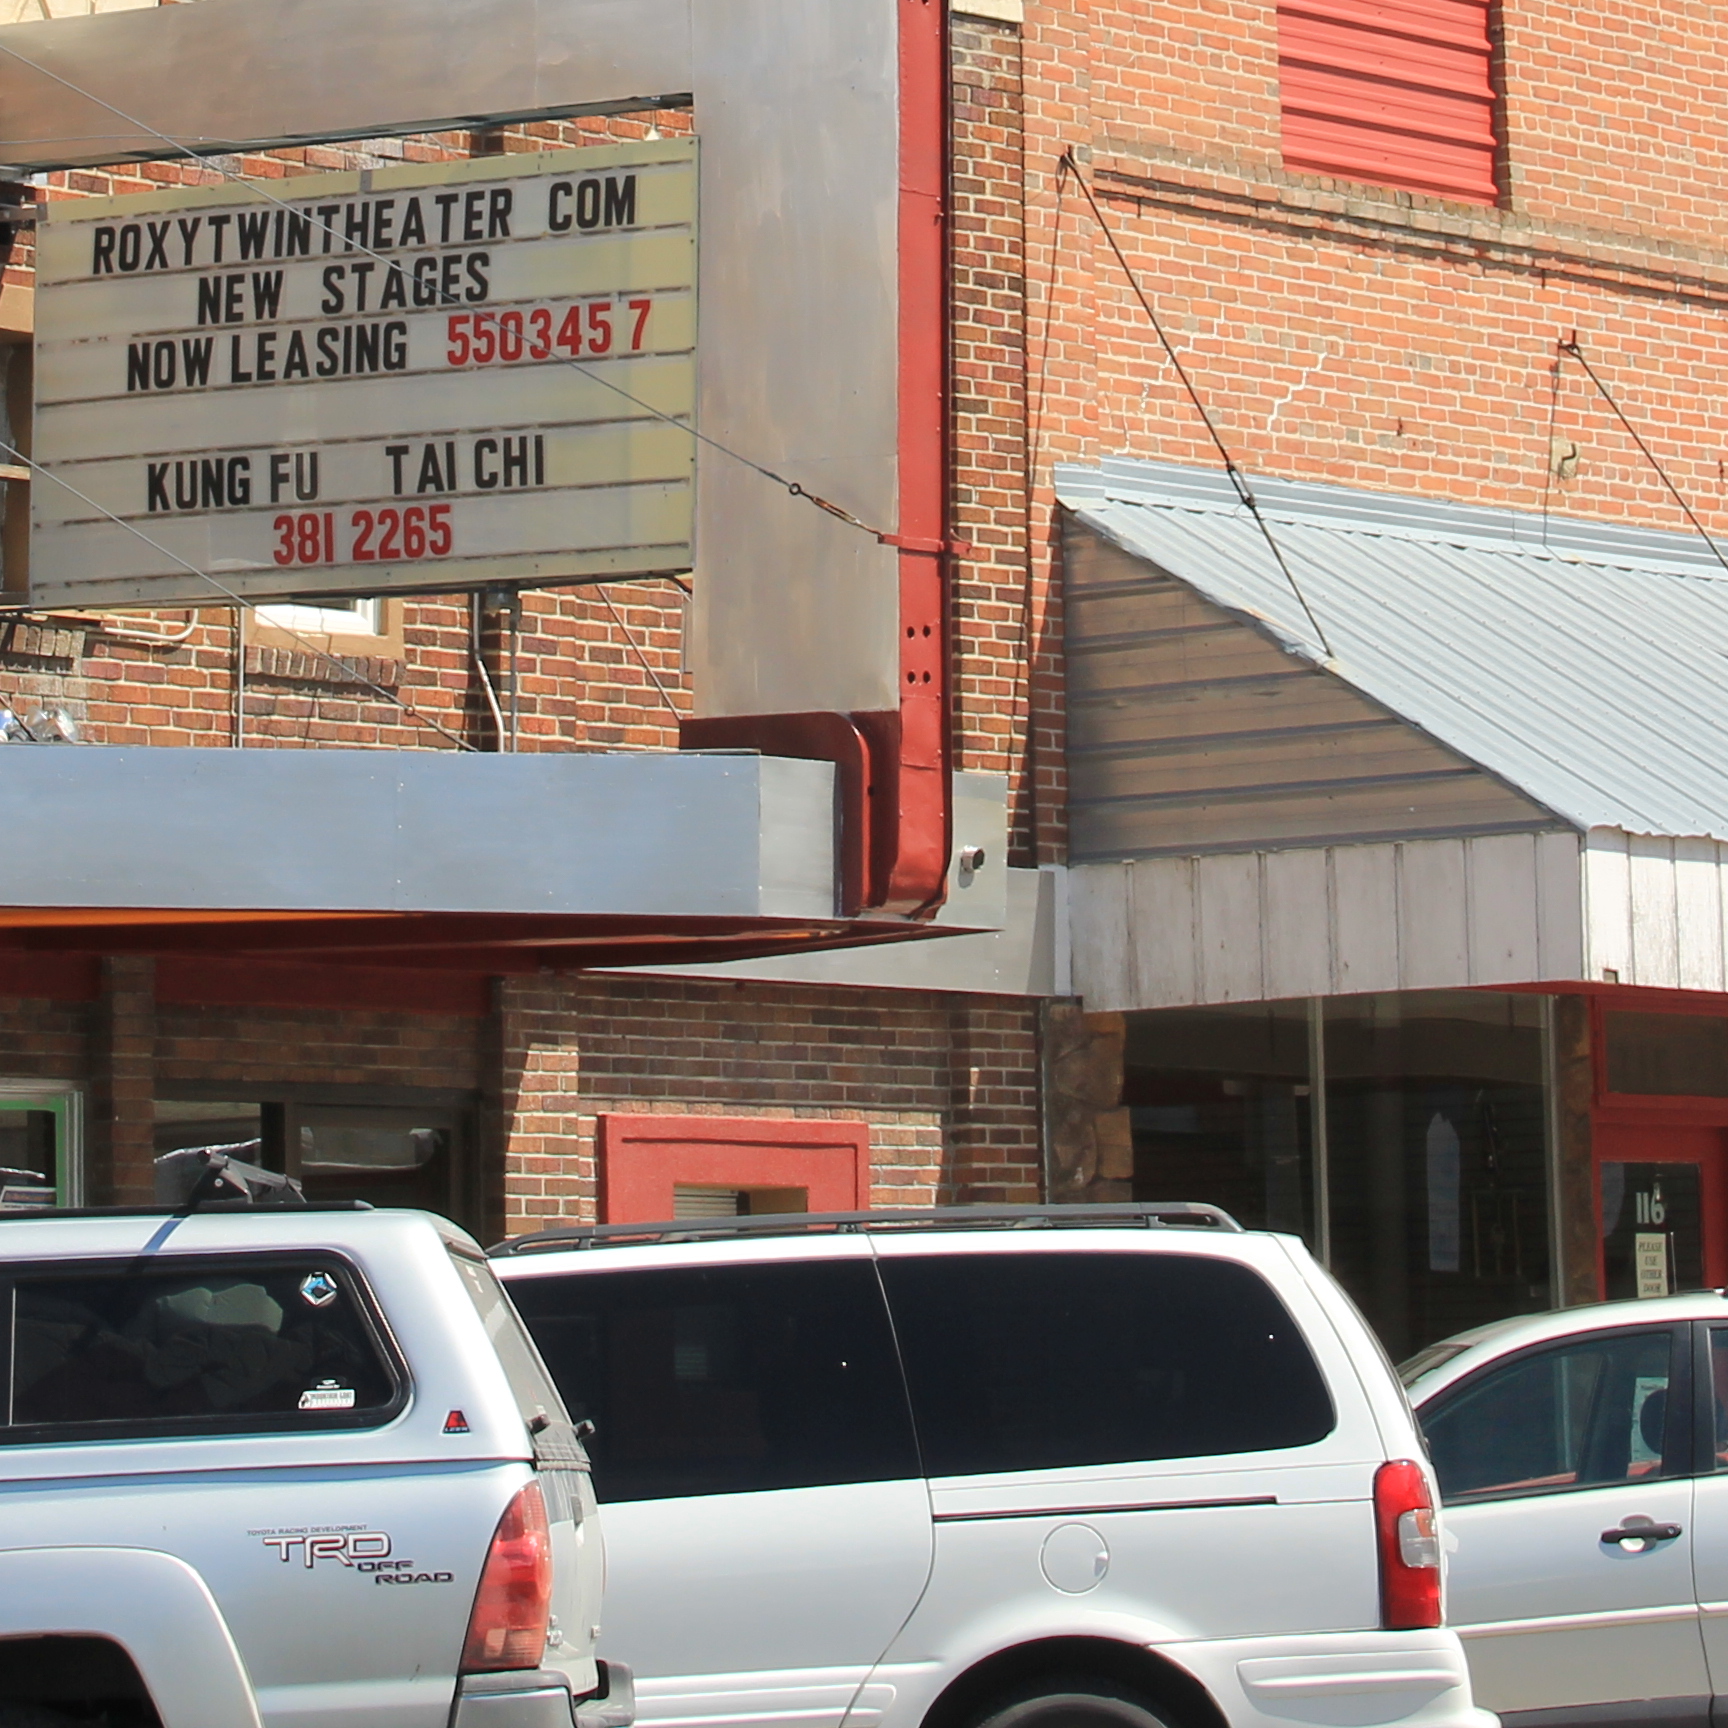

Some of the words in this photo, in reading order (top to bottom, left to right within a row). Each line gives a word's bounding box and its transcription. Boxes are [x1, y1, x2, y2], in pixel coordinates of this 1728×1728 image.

[92, 186, 514, 275] ROXYTWINTHEATER
[548, 174, 637, 233] COM
[196, 269, 284, 326] NEW
[320, 251, 491, 315] STAGES
[126, 336, 214, 392] NOW
[229, 320, 408, 384] LEASING
[146, 455, 252, 512] KUNG
[270, 451, 319, 504] FU
[385, 440, 458, 496] TAI
[473, 434, 546, 490] CHI
[351, 503, 453, 562] 2265
[1635, 1181, 1666, 1225] 116
[262, 1530, 392, 1569] TRD
[357, 1560, 415, 1573] OFF
[374, 1572, 456, 1585] ROAD
